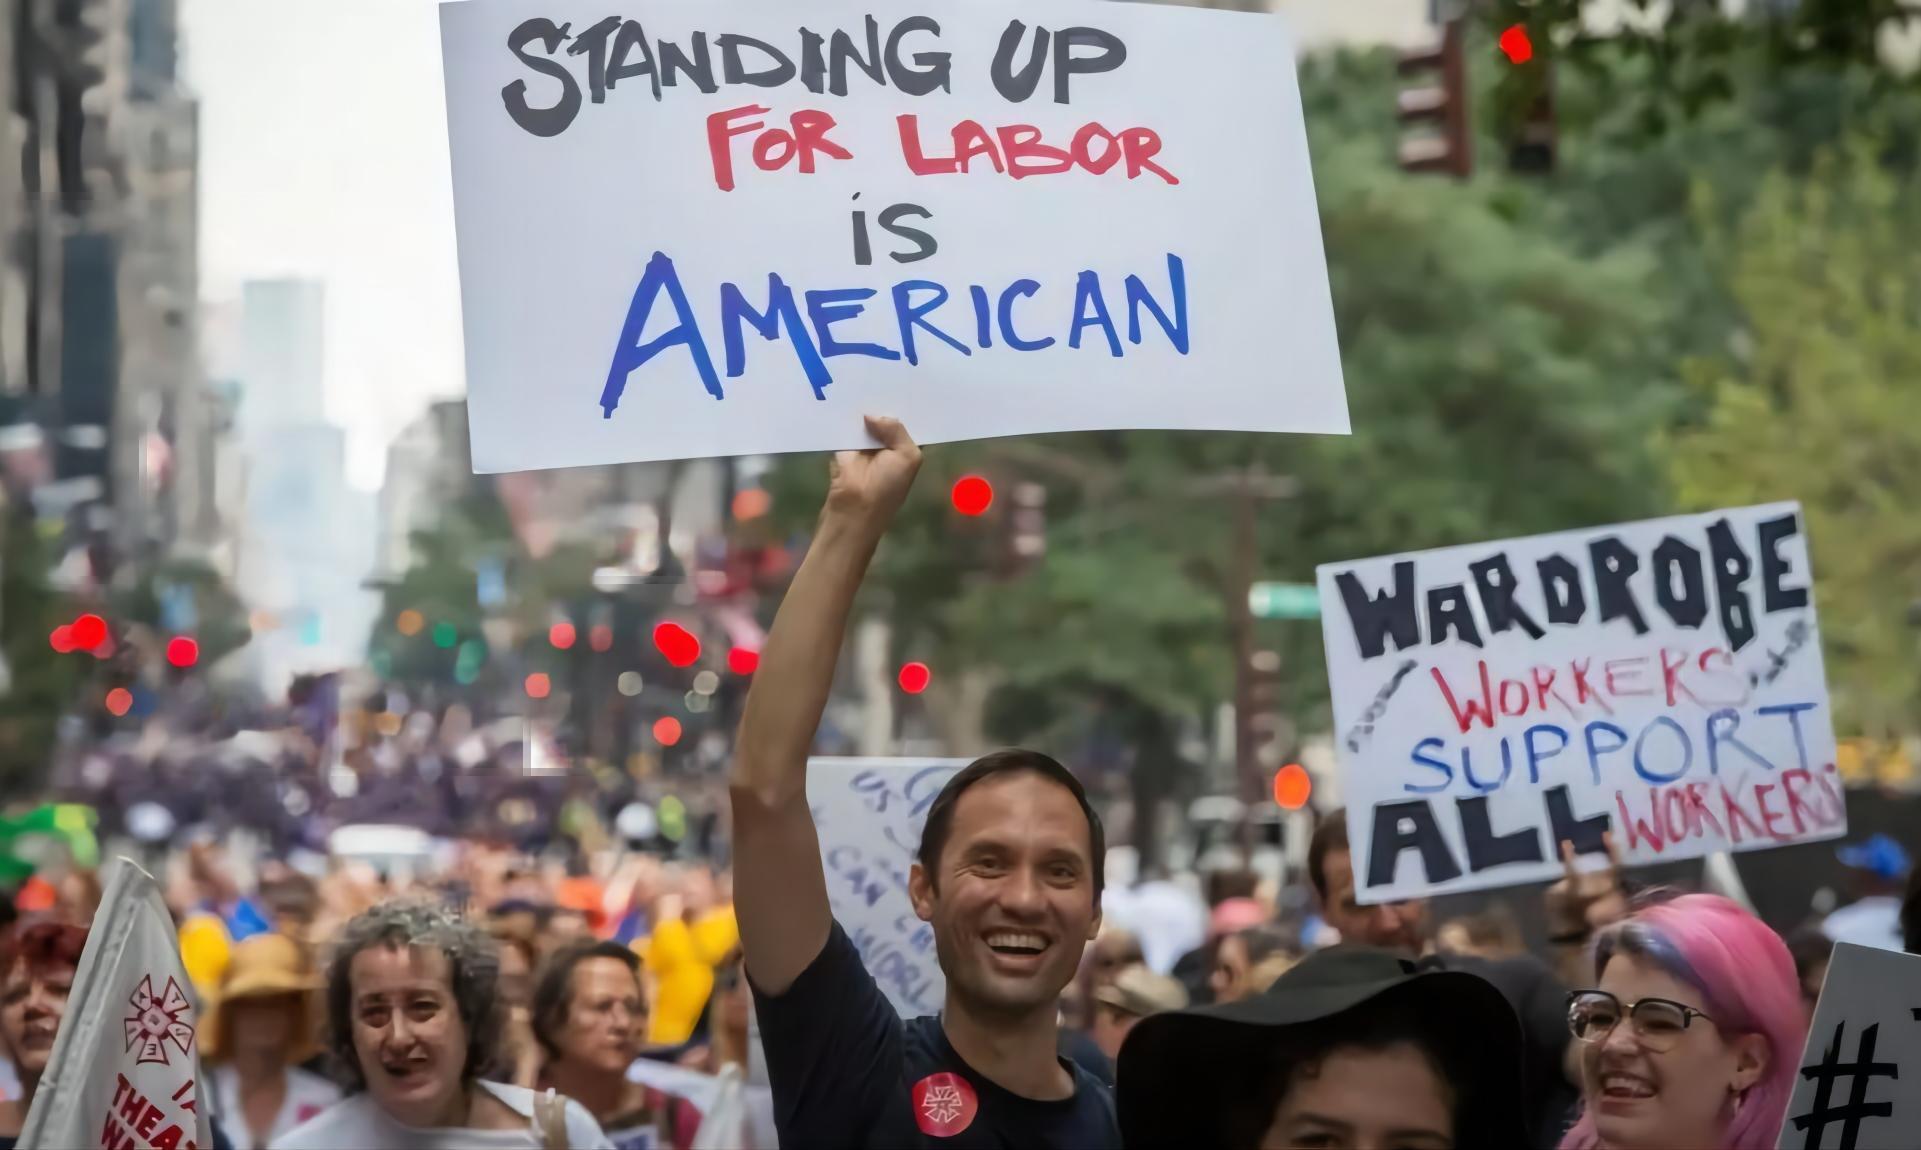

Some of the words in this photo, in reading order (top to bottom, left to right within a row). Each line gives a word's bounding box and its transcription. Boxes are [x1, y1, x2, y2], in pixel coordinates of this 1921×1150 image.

[502, 15, 951, 137] STANDING
[991, 20, 1127, 104] UP
[707, 104, 853, 191] FOR
[896, 113, 1180, 186] LABOR
[599, 251, 1190, 419] AMERICAN
[1335, 514, 1808, 659] WARDROBE
[1431, 647, 1750, 733] WORKERS
[1404, 702, 1818, 793] SUPPORT
[1366, 784, 1611, 888] ALL
[1615, 762, 1844, 853] WORKERS
[112, 1072, 196, 1150] THEA
